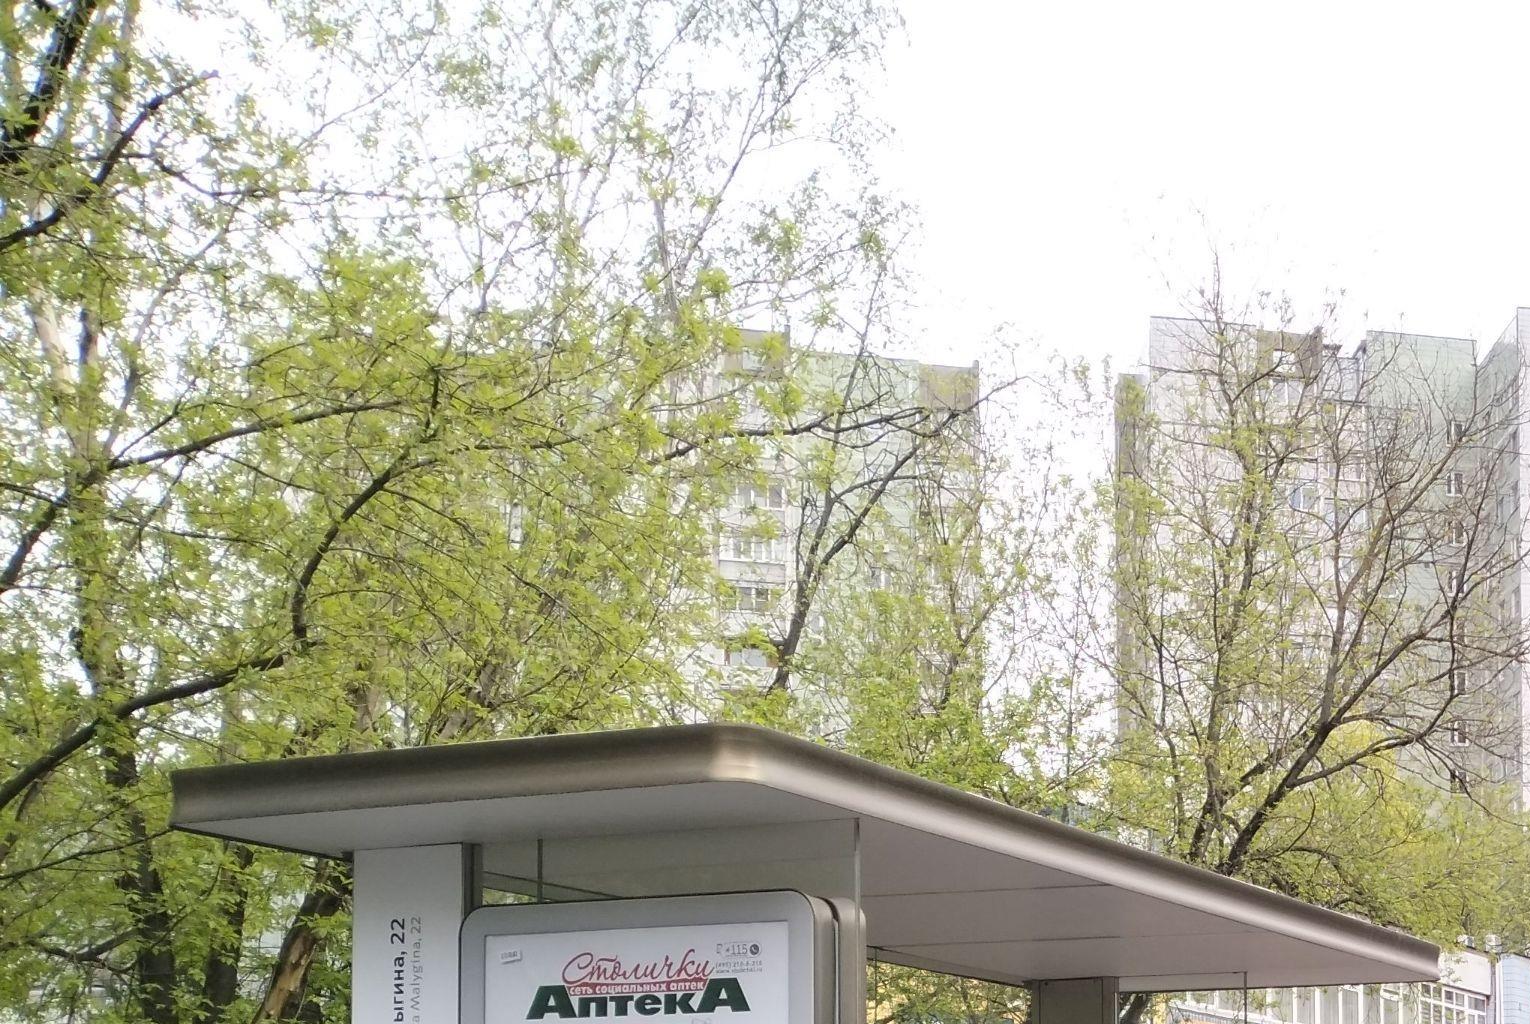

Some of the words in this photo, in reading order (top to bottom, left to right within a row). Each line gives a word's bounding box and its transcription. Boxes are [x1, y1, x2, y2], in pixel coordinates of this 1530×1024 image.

[390, 918, 405, 945] 22
[411, 916, 421, 934] 22
[410, 937, 423, 1010] Malygina,
[562, 949, 715, 984] Столички
[570, 986, 593, 996] сеть
[596, 983, 667, 995] социальных
[669, 981, 705, 992] аптек
